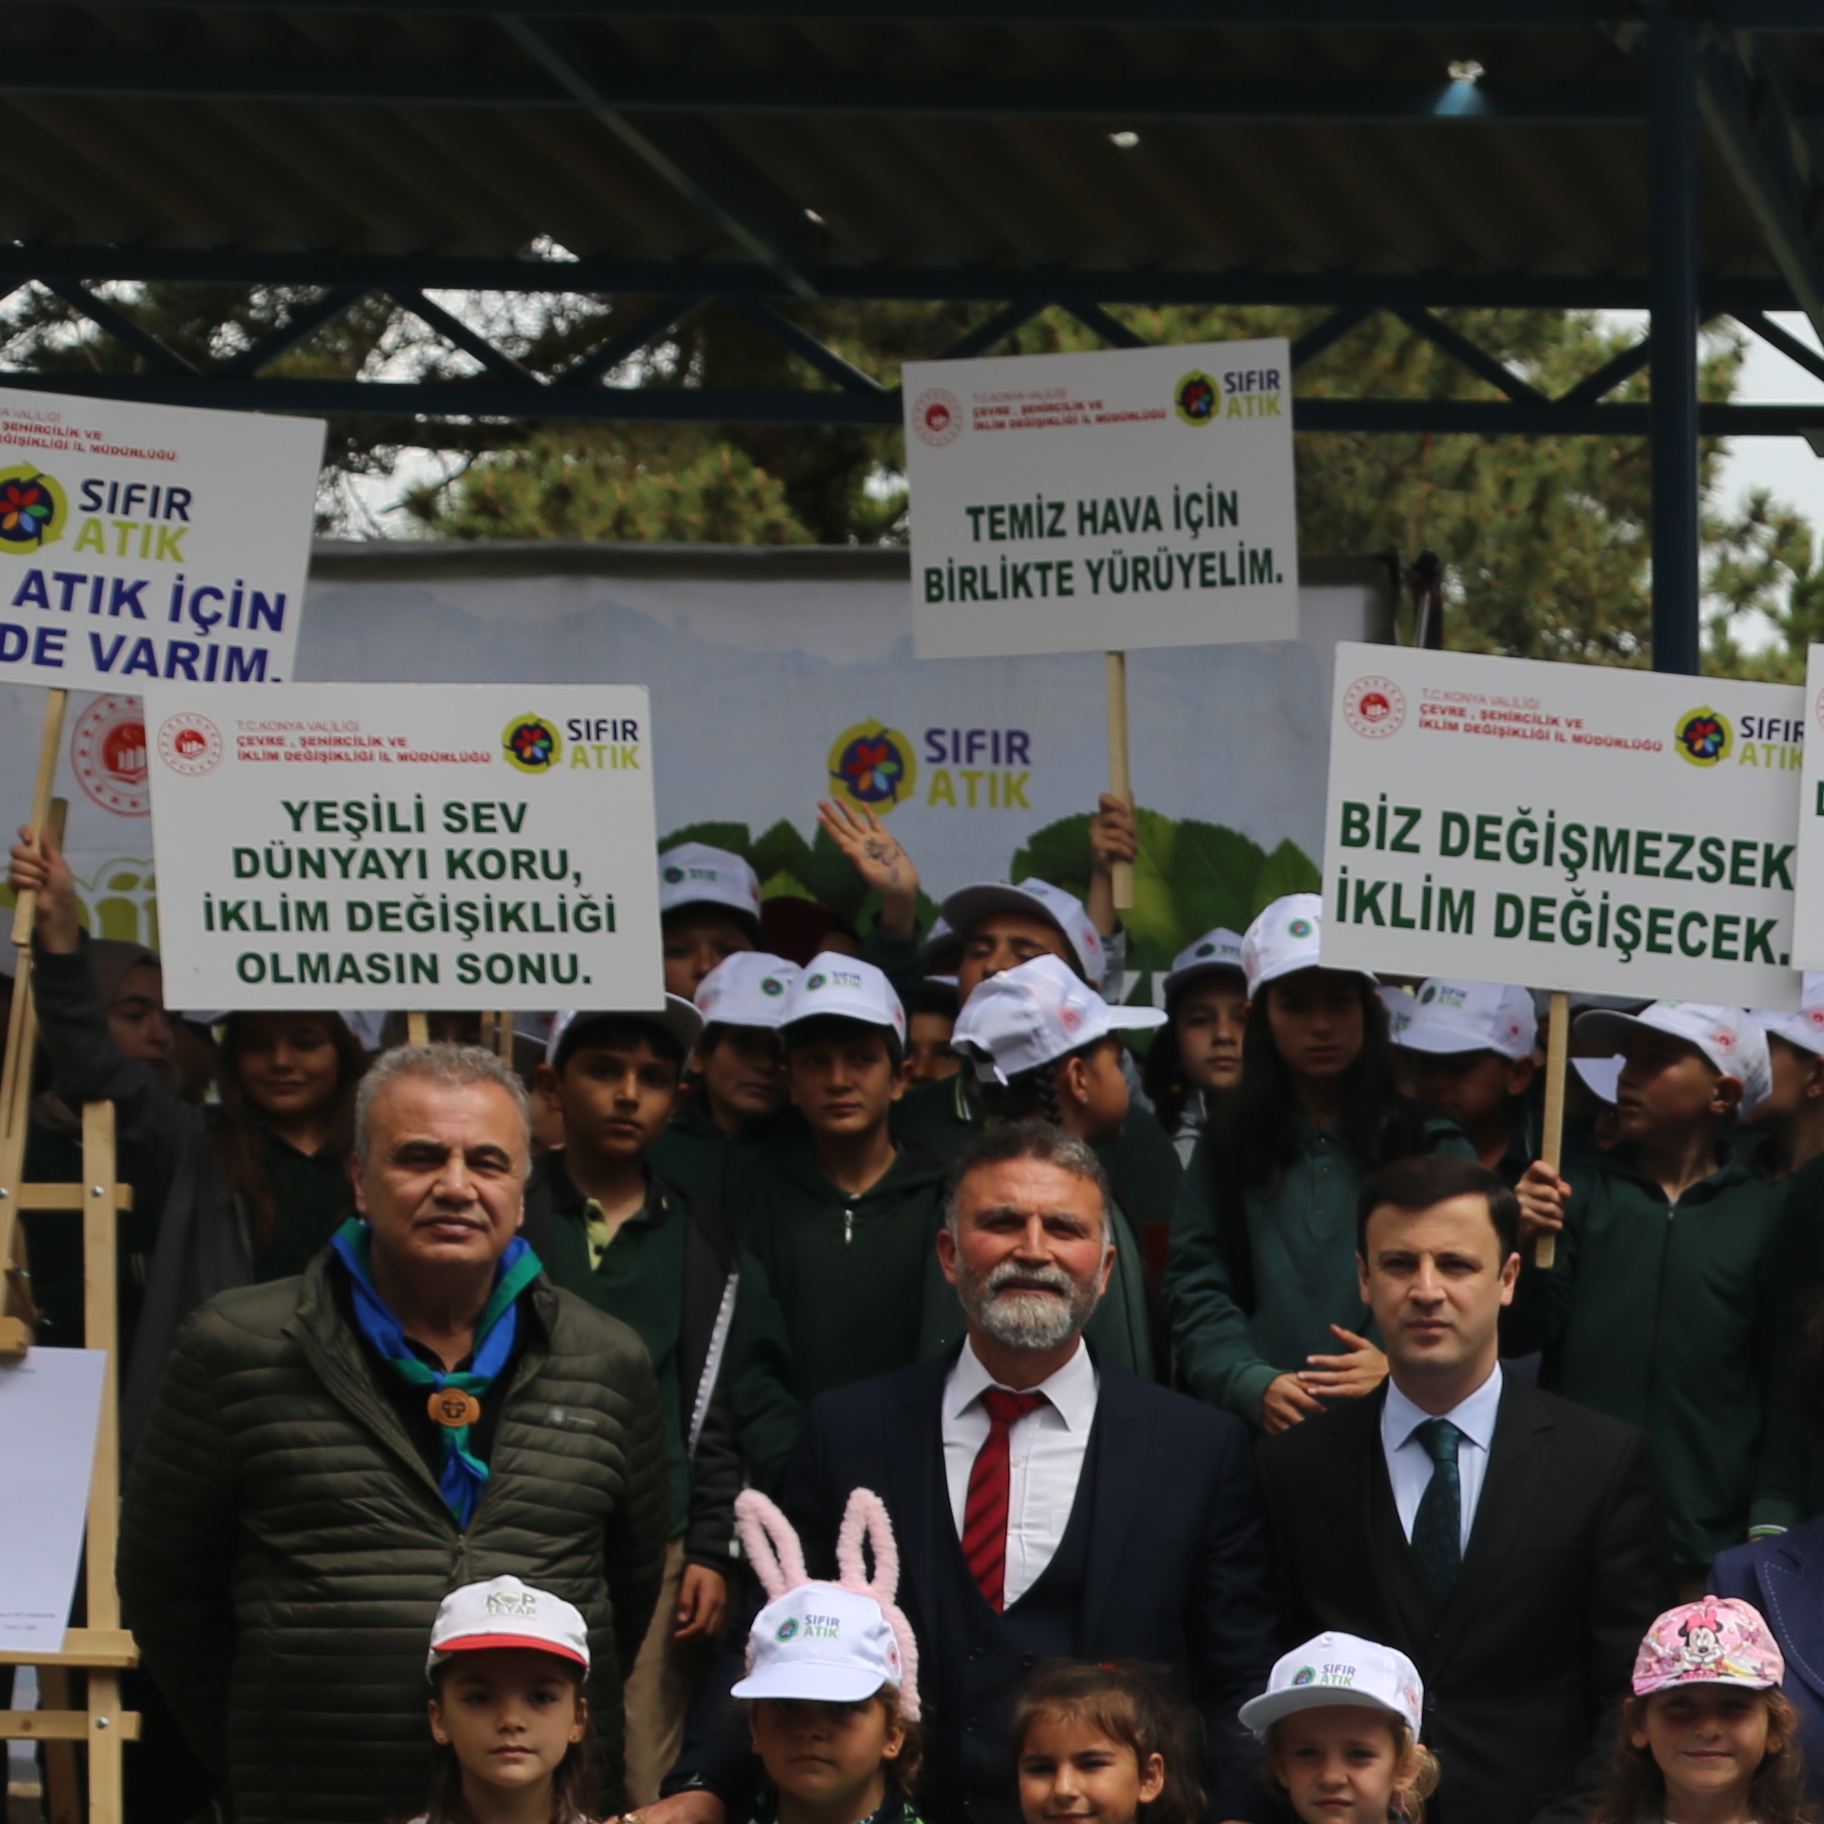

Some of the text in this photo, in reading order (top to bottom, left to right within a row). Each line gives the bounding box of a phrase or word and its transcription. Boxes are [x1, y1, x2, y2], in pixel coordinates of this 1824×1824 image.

[1224, 368, 1281, 394] SIFIR
[1226, 394, 1281, 418] ATIK
[78, 478, 192, 521] SIFIR
[965, 482, 1238, 542] TEMİZ HAVA İÇİN
[72, 516, 188, 563] ATIK
[924, 540, 1283, 603] BİRLİKTE YÜRÜYELİM.
[10, 568, 286, 636] ATIK İÇİN
[88, 630, 282, 682] VARIM.
[567, 718, 639, 742] SIFIR
[923, 726, 1031, 766] SIFIR
[569, 745, 640, 770] ATIK
[926, 768, 1032, 810] ATIK
[281, 792, 527, 841] YEŞİLİ SEV
[232, 840, 582, 886] DÜNYAYI KORU,
[1341, 792, 1796, 890] BİZ DEĞİŞMEZSEK
[202, 892, 616, 941] İKLİM DEĞİŞİKLİĞİ
[1337, 865, 1789, 967] İKLİM DEĞİŞECEK.
[236, 952, 591, 984] OLMASIN SONU.
[803, 1625, 838, 1638] ATIK
[805, 1614, 840, 1627] SIFIR
